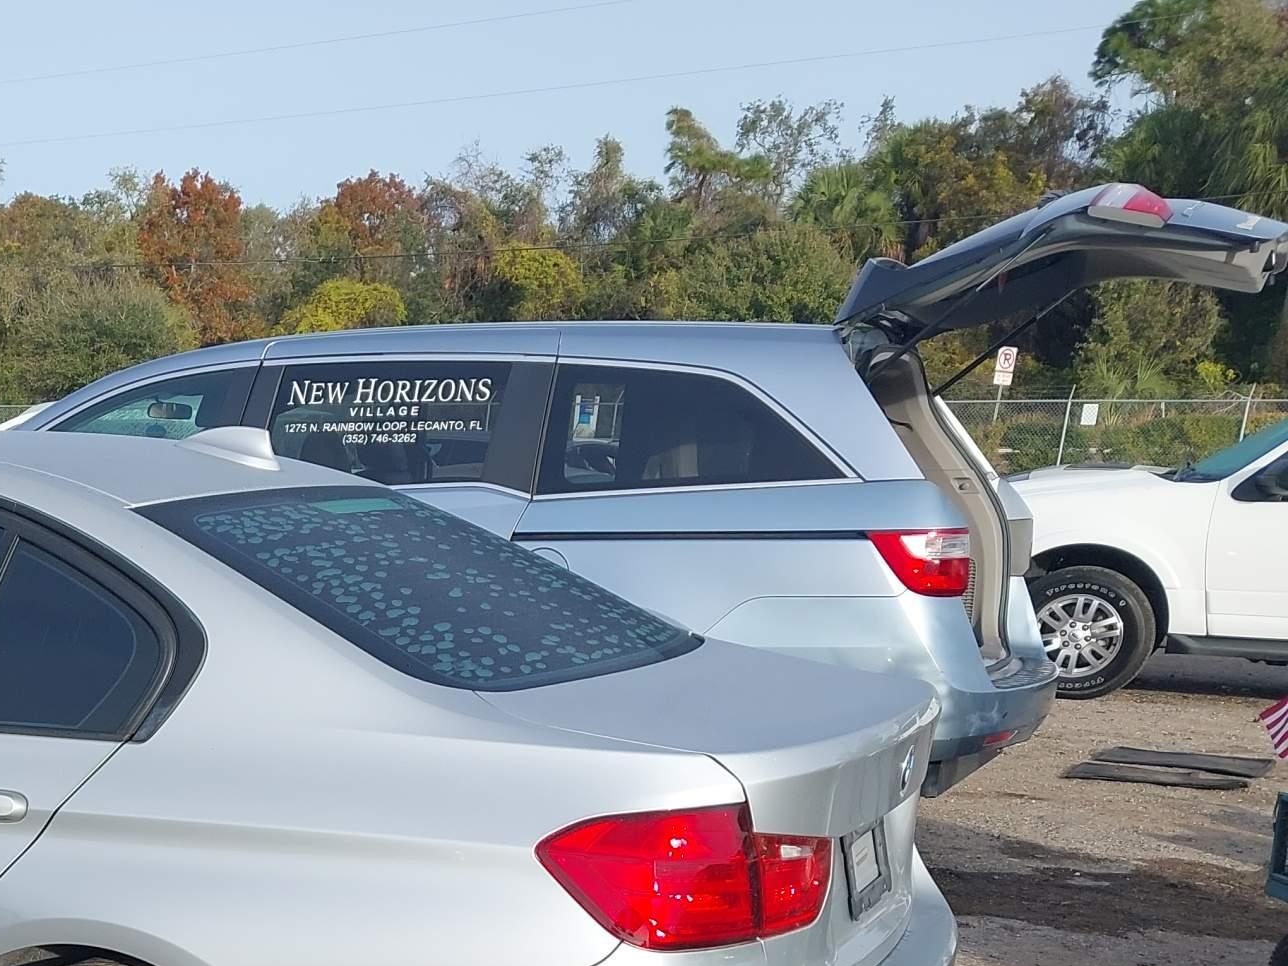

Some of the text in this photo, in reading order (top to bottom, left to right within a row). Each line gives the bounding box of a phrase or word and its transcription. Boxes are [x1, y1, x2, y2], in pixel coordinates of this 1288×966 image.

[287, 378, 492, 405] NEW HORIZONS
[349, 405, 420, 417] VILLAGE
[285, 420, 483, 433] 1275 N. RAINBOW LOOP, LECANTO, FL
[342, 433, 417, 444] (352) 746-3262
